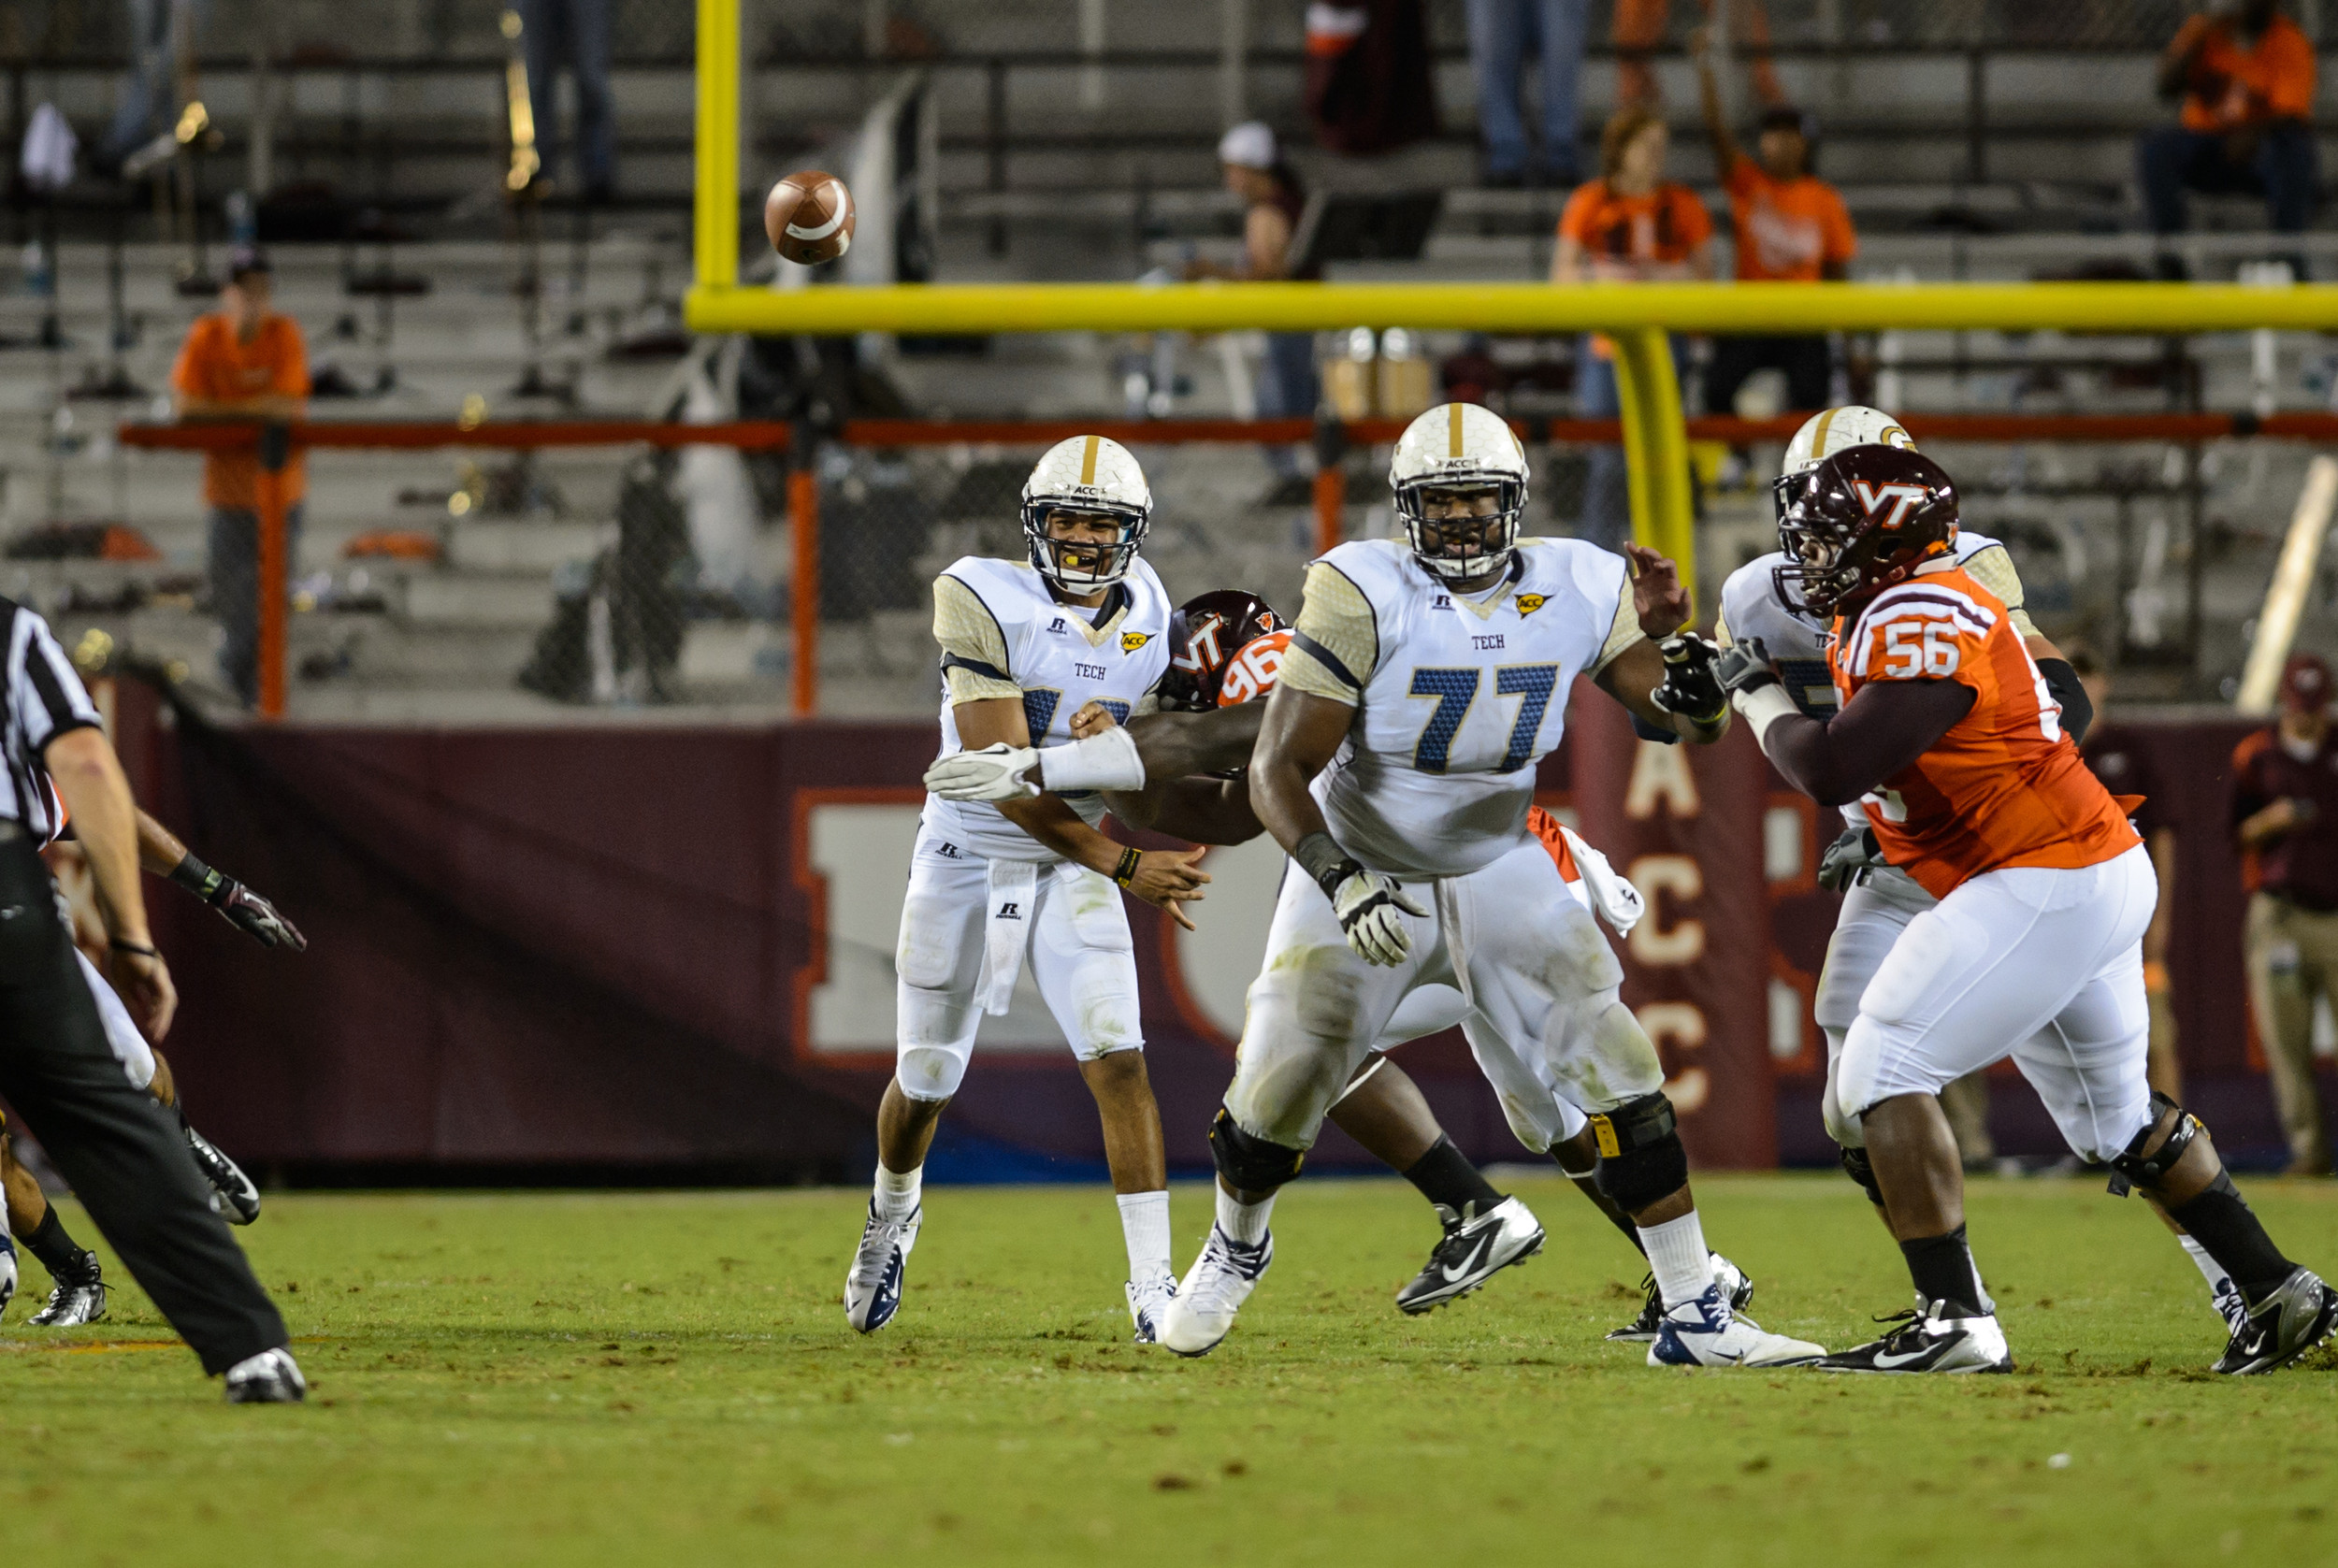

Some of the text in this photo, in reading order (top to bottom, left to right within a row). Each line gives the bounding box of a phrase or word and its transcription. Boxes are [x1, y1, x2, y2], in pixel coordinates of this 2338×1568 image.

[1075, 486, 1097, 496] ACC
[1852, 480, 1928, 530] VT
[1518, 598, 1541, 608] ACC
[1122, 637, 1144, 646] ACC
[1171, 612, 1224, 674] VT
[1471, 634, 1506, 651] TECH
[1883, 621, 1961, 679] 56
[1075, 662, 1107, 681] TECH
[1221, 639, 1282, 703] 96
[1406, 662, 1561, 776] 77
